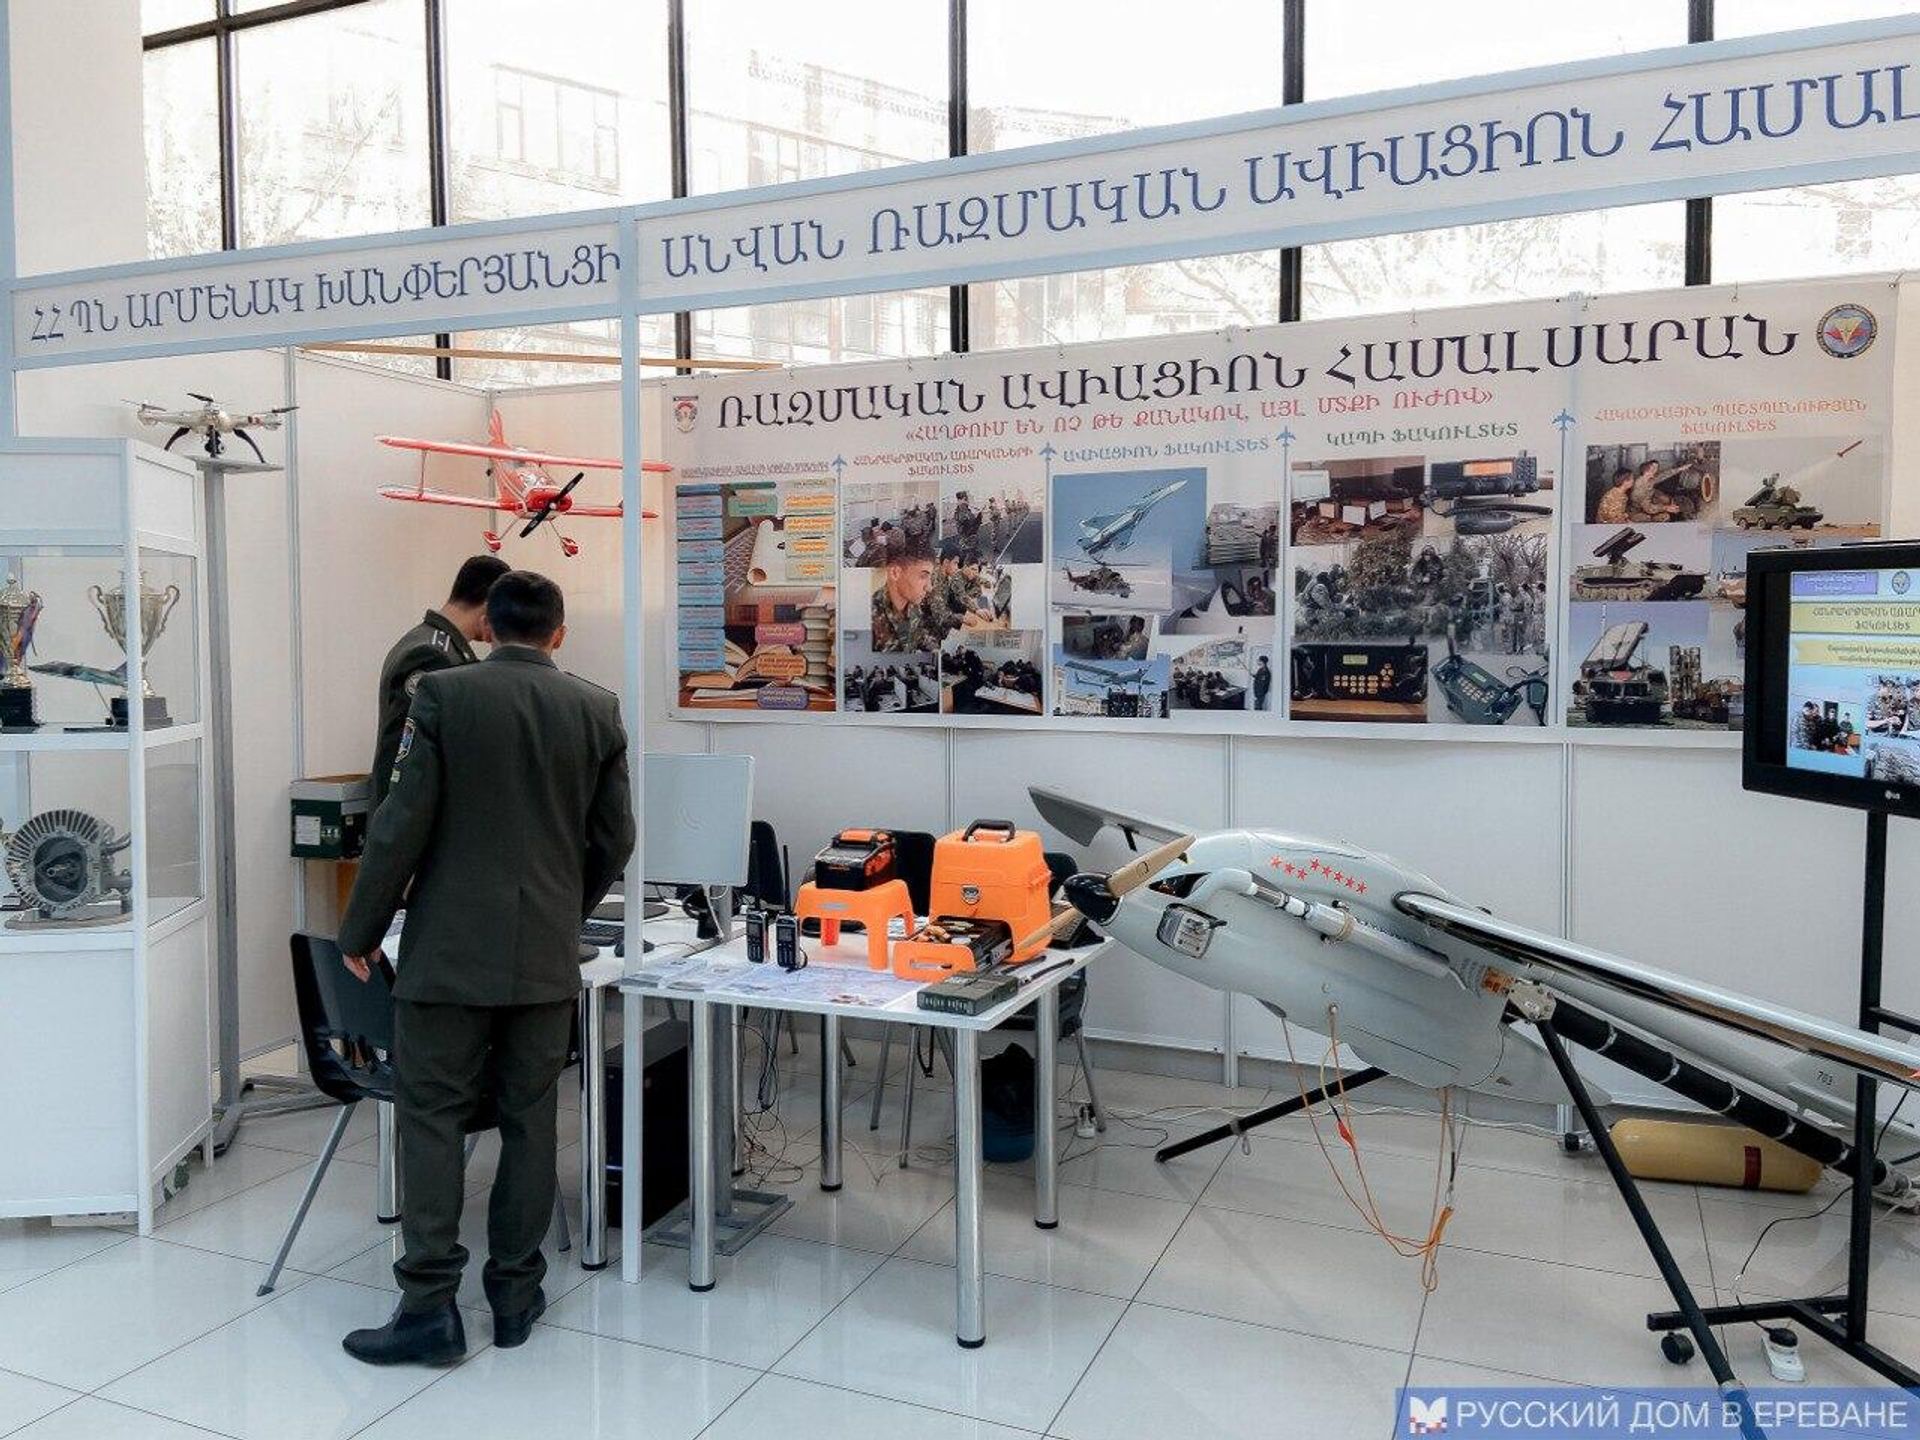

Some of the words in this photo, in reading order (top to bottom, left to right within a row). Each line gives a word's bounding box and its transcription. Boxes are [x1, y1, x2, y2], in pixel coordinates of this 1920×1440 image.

[662, 219, 844, 278] ԱՆՎԱՆ
[867, 166, 1226, 254] ՌԱԶՄԱԿԱՆ
[1245, 107, 1624, 204] ԱՎԻԱՑԻՈՆ
[1650, 65, 1920, 152] ՀԱՄԱԼ
[31, 304, 64, 341] ՀՀ
[70, 299, 118, 332] ՊՆ
[126, 277, 303, 328] ԱՐՄԵՆԱԿ
[315, 243, 621, 310] ԽԱՆՓԵՐՅԱՆՑԻ
[717, 376, 984, 429] ՌԱԶՄԱԿԱՆ
[1001, 351, 1310, 410] ԱՎԻԱՑԻՈՆ
[1325, 312, 1799, 388] ՀԱՄԱԼՍԱՐԱՆ
[1015, 418, 1044, 435] ԵՆ
[1053, 416, 1082, 432] ՈՉ
[1091, 413, 1123, 430] ԹԵ
[1261, 399, 1305, 418] ԱՅԼ
[1318, 394, 1380, 415] ՄՏՔԻ
[1326, 429, 1385, 446] ԿԱՊԻ
[1391, 422, 1519, 443] ՖԱԿՈՒԼՏԵՏ
[1681, 418, 1776, 435] ՖԱԿՈՒԼՏԵՏ
[1164, 436, 1269, 456] ՖԱԿՈՒԼՏԵՏ
